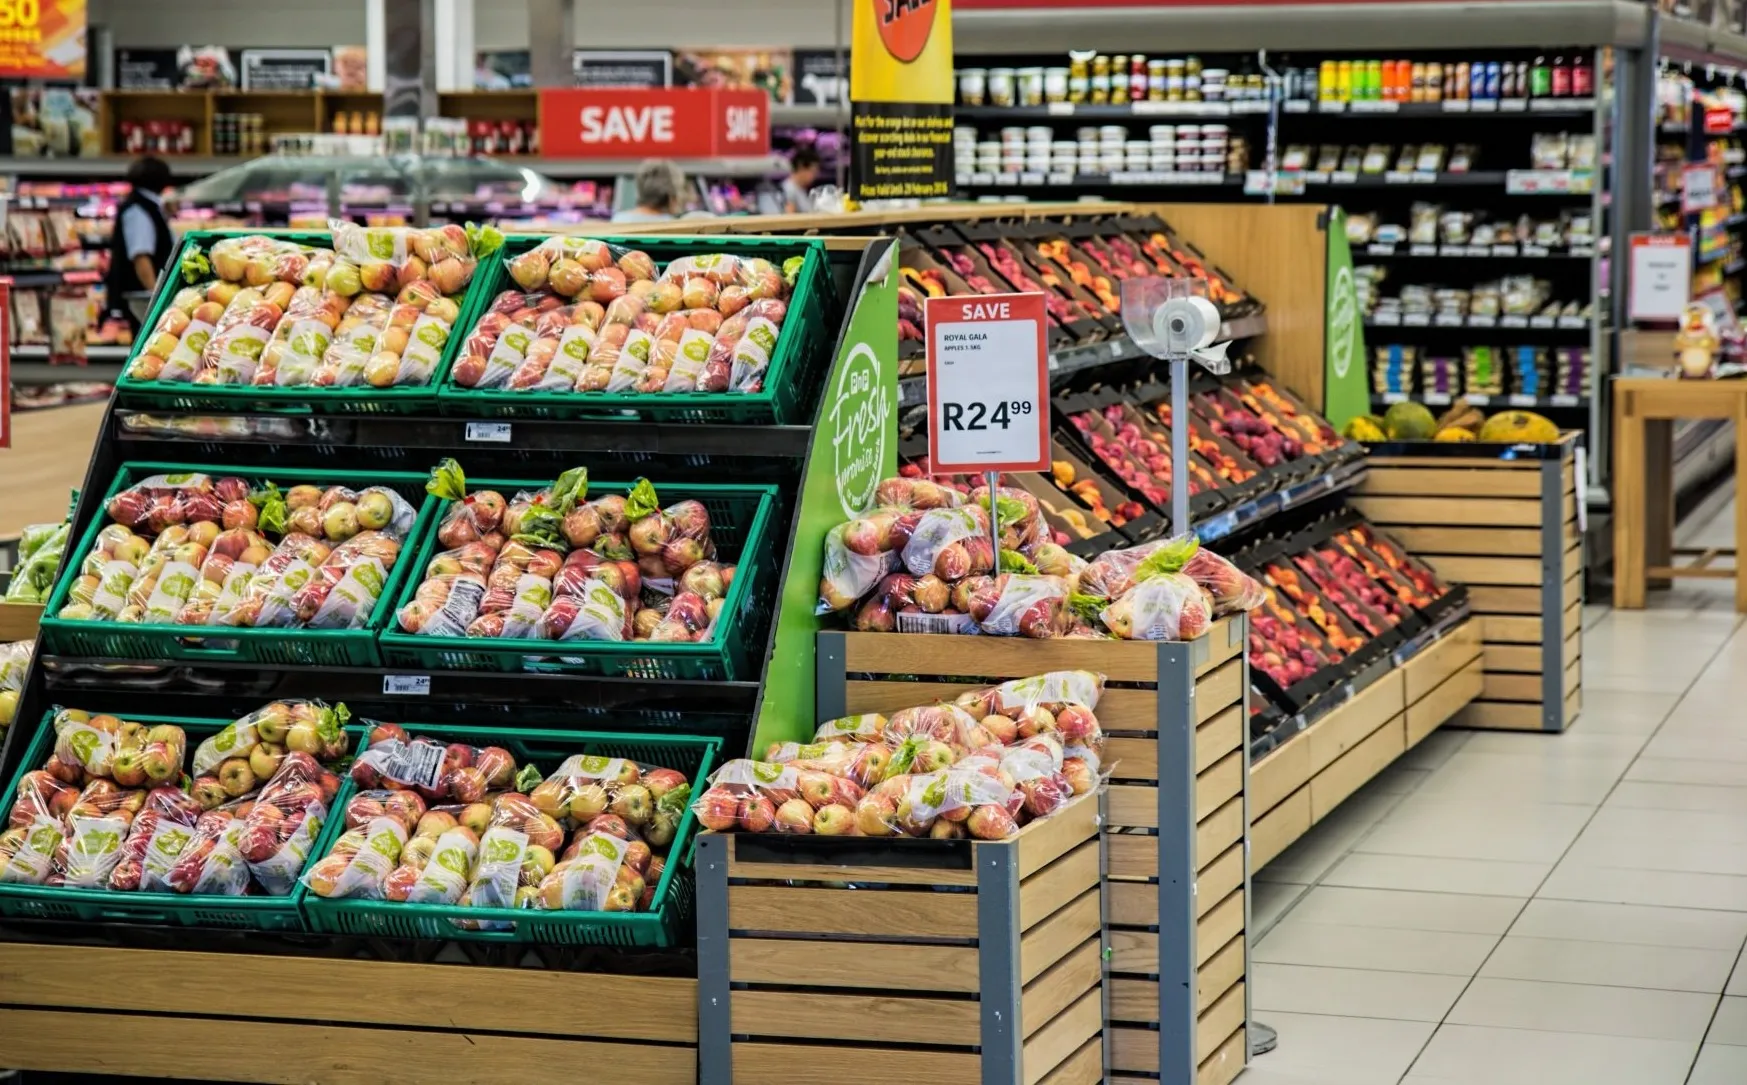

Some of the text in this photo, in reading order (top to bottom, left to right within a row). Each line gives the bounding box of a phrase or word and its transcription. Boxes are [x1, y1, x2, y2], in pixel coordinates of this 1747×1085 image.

[580, 105, 675, 143] SAVE
[725, 105, 759, 142] SAVE
[962, 302, 1010, 320] SAVE
[969, 333, 987, 341] GALA
[851, 369, 870, 394] PnP
[829, 361, 890, 458] Fresh
